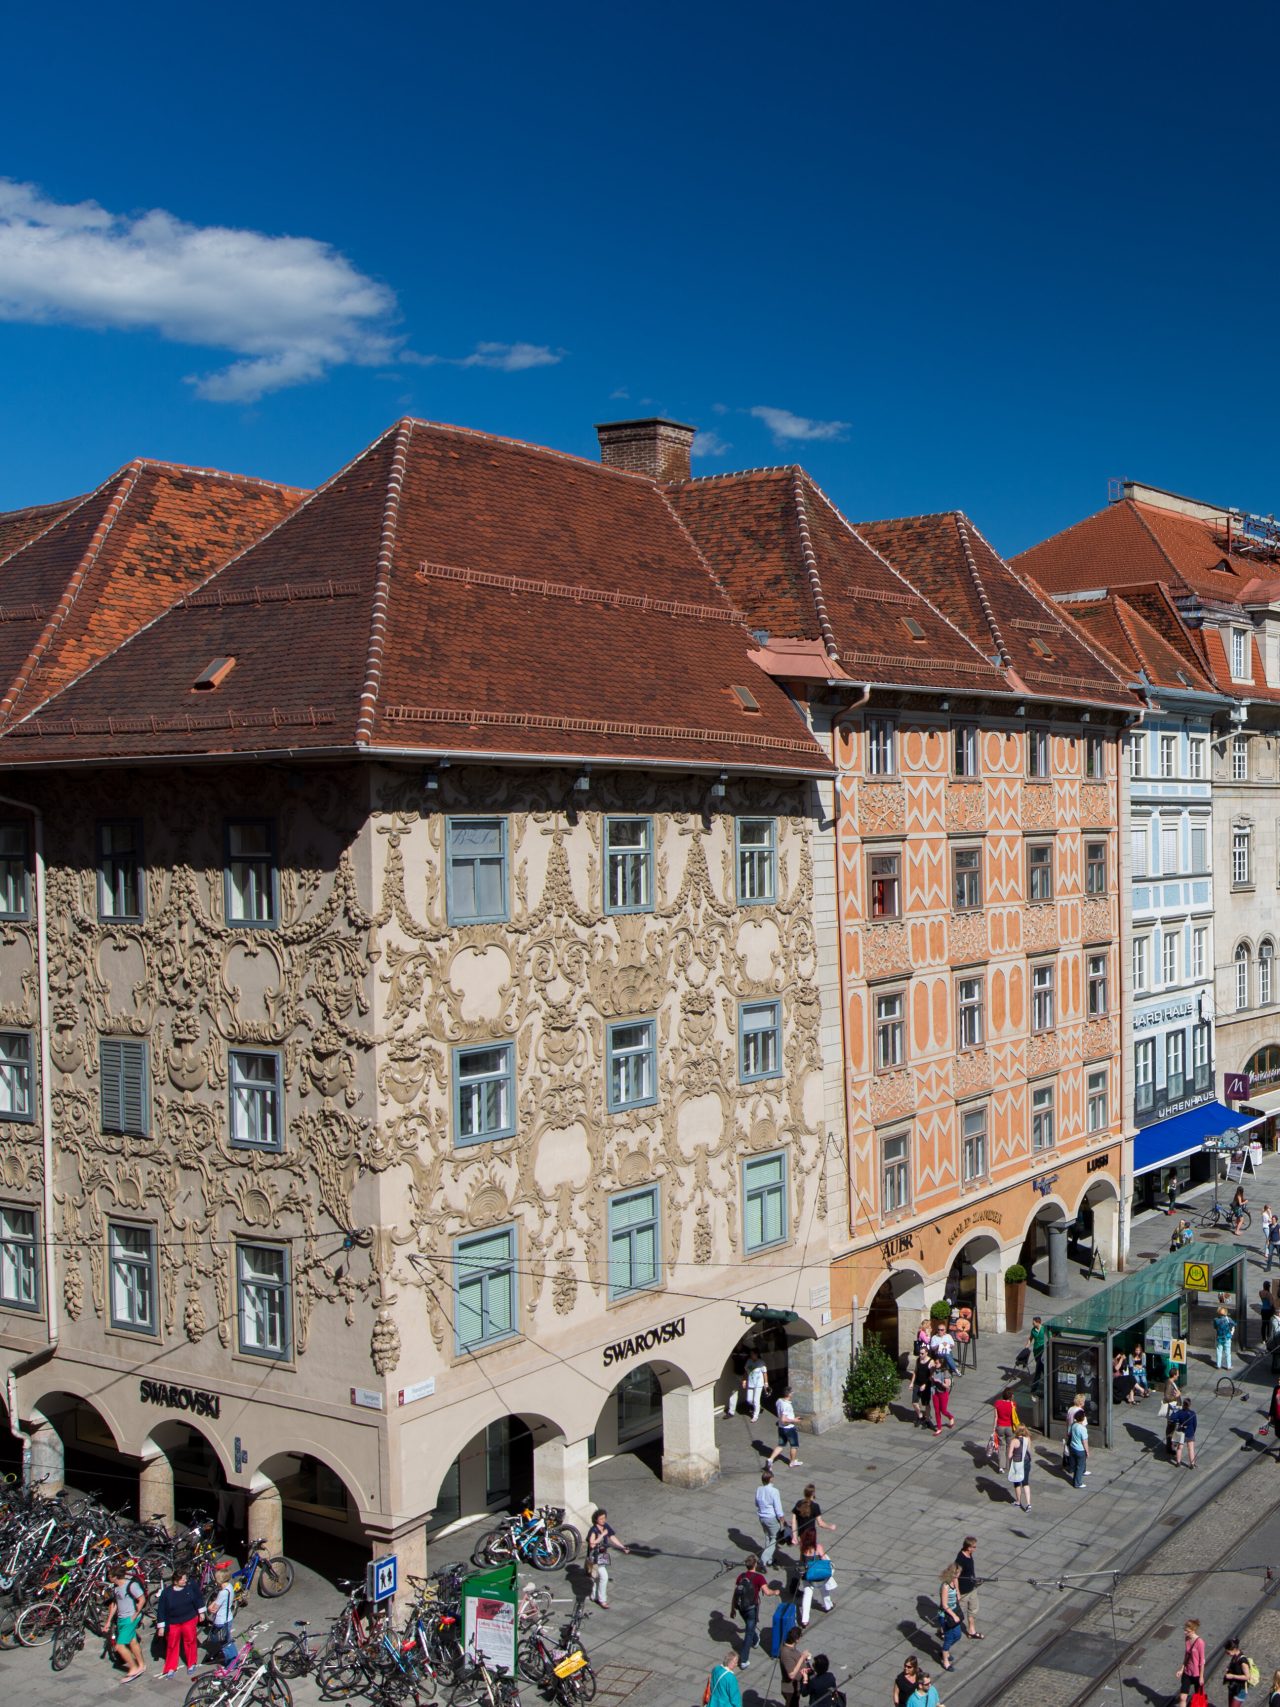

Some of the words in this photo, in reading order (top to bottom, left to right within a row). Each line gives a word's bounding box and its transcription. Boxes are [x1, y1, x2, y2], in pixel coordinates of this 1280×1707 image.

[1158, 1090, 1215, 1118] UHRENHAUS
[881, 1233, 913, 1260] AUER
[603, 1317, 685, 1367] SWAROVSKI
[1173, 1343, 1183, 1359] A
[140, 1379, 220, 1420] SWAROVSKI
